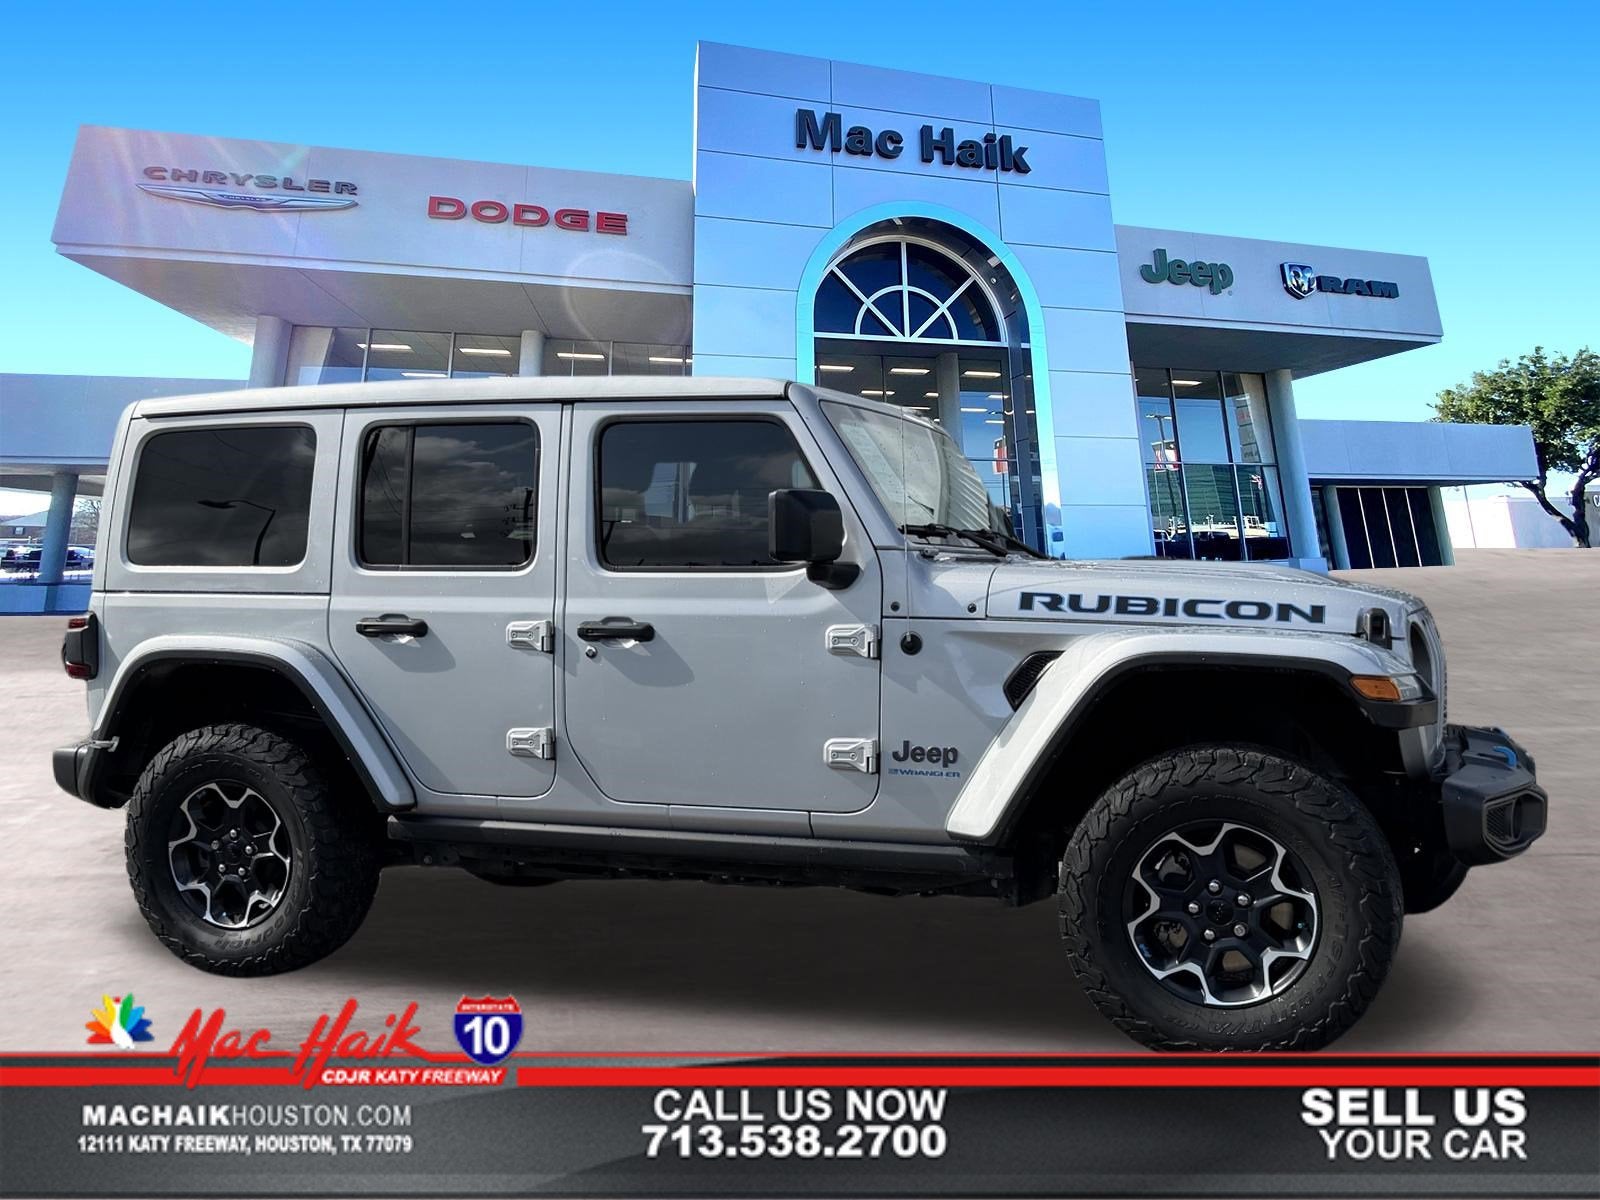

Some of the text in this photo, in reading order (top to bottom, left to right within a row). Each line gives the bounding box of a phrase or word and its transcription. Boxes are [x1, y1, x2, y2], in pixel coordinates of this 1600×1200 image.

[796, 108, 1032, 174] Mac Haik
[143, 166, 358, 195] CHRYSLER
[427, 195, 628, 236] DODGE
[1139, 248, 1234, 295] Jeep
[1316, 275, 1399, 299] RAM
[1018, 591, 1326, 624] RUBICON
[892, 740, 958, 768] Jeep
